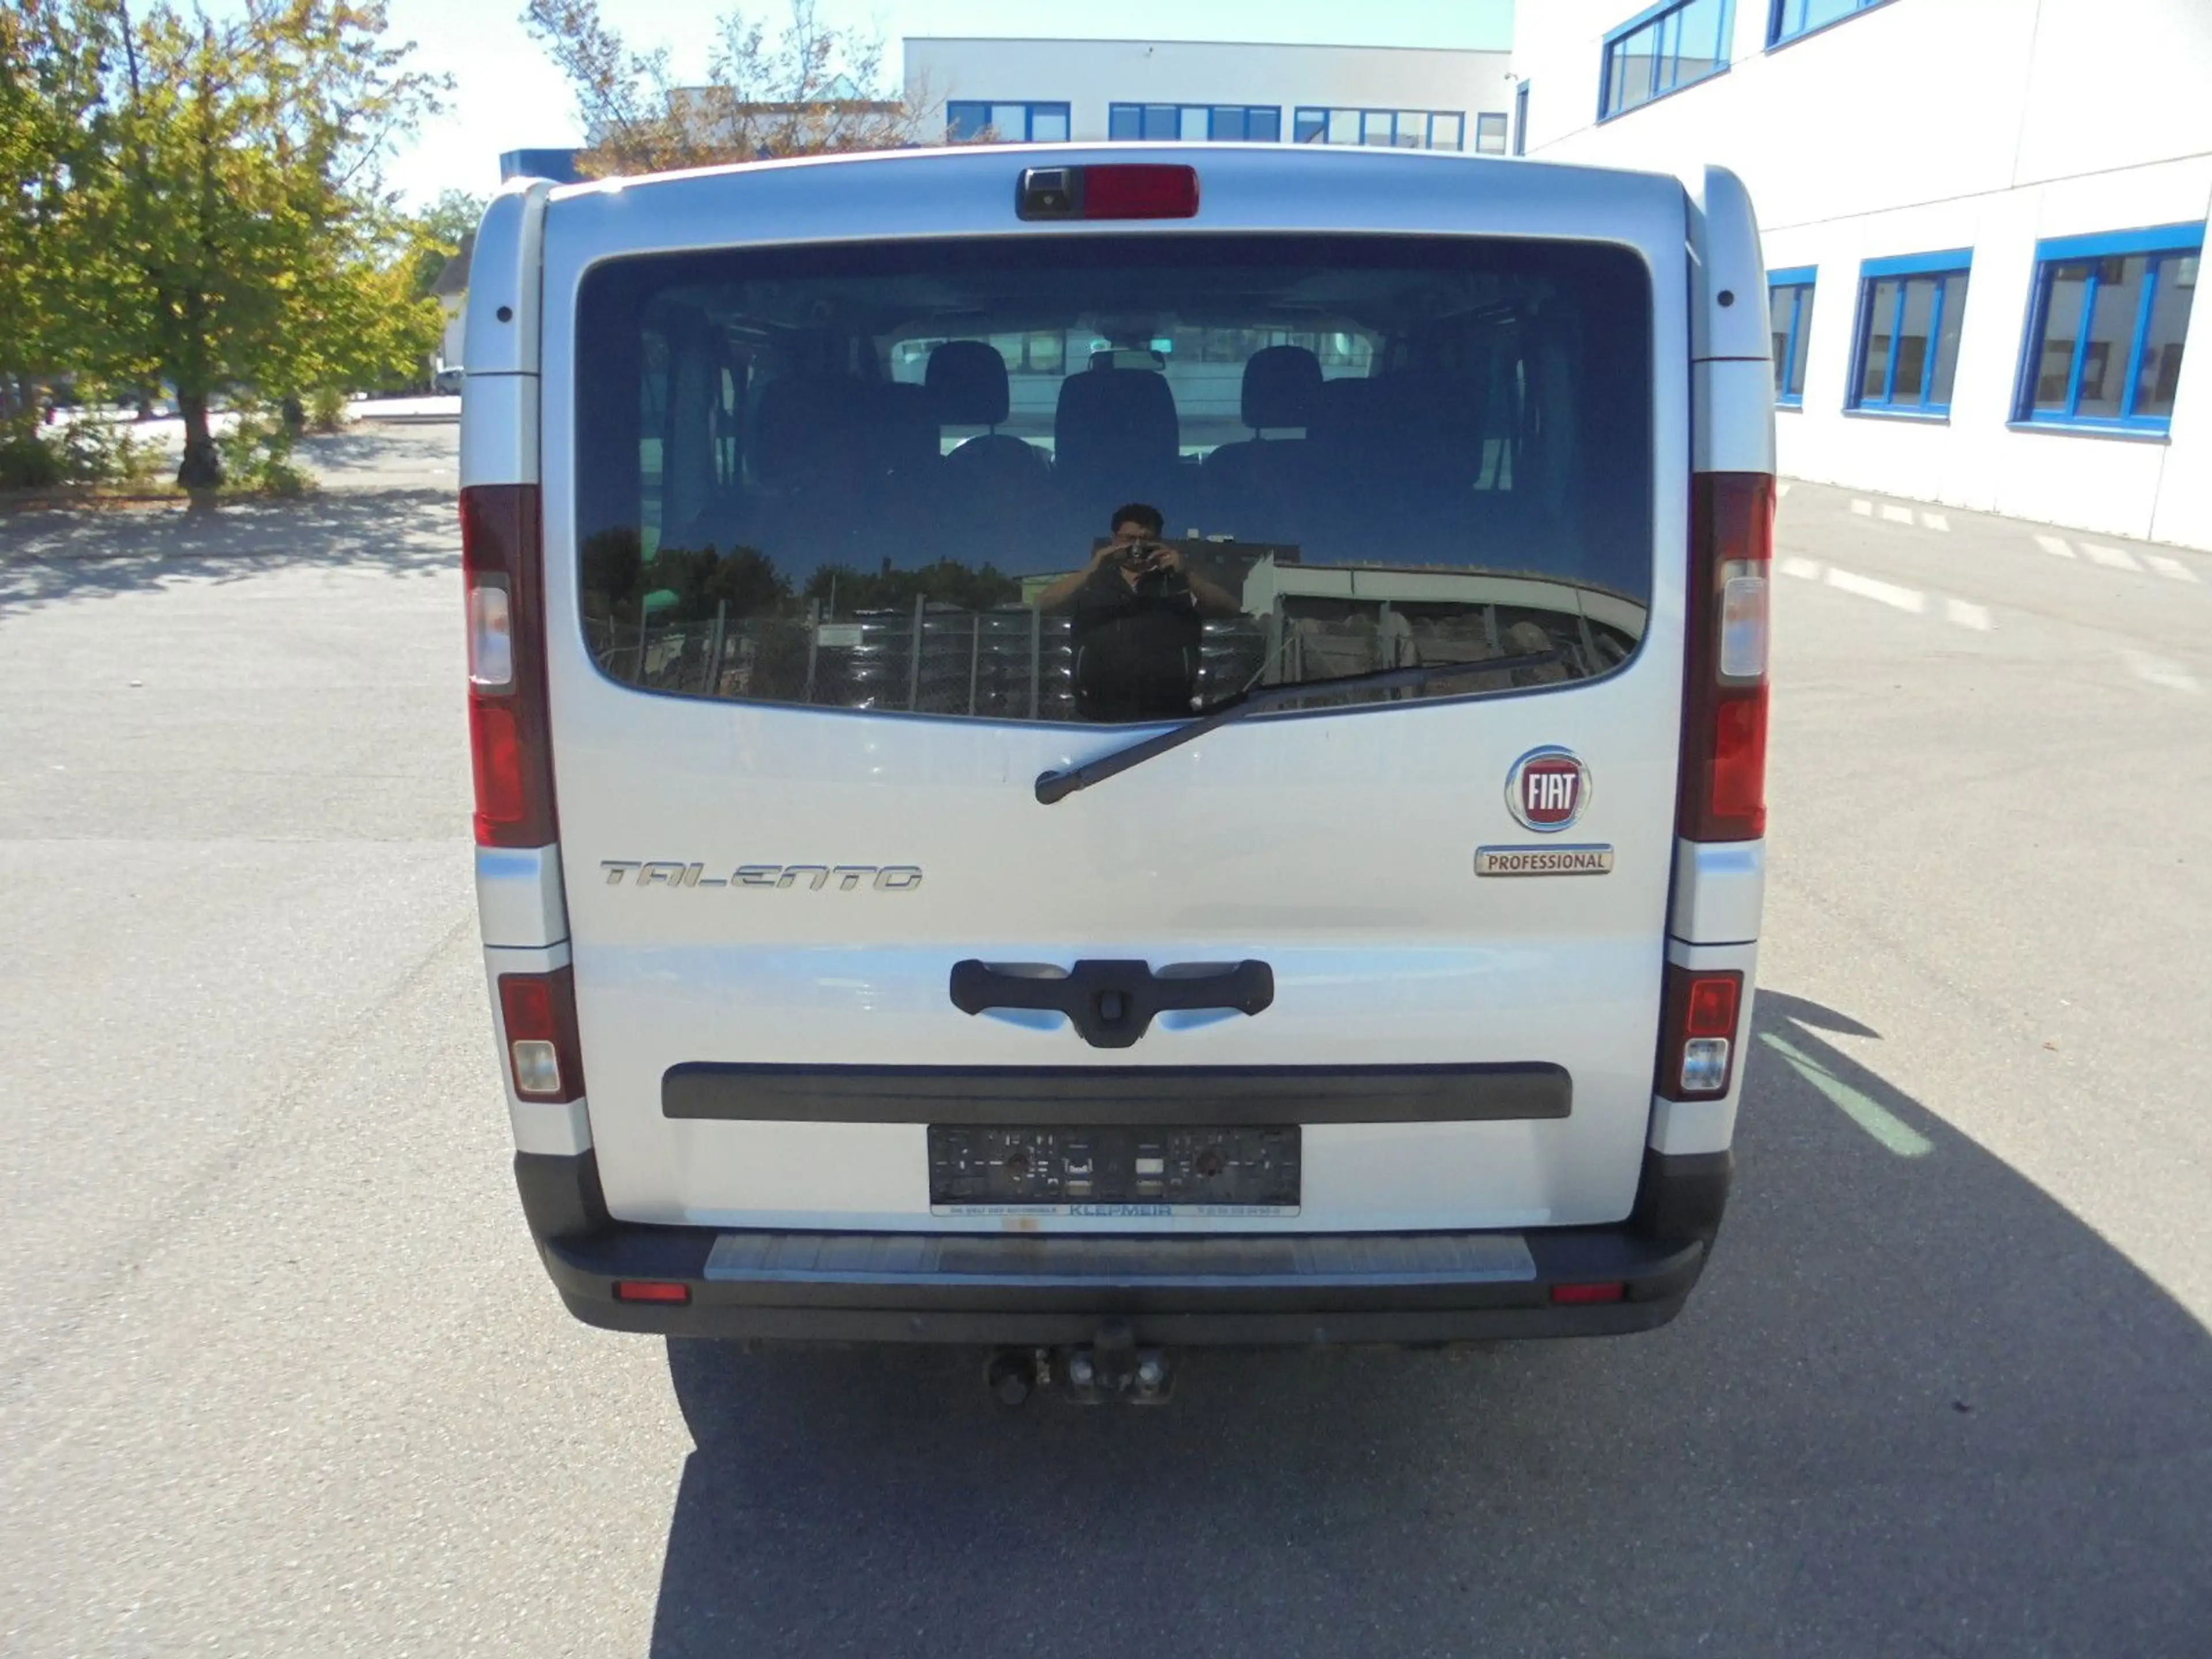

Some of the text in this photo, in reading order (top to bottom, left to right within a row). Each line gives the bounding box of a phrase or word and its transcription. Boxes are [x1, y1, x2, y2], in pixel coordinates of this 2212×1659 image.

[1528, 774, 1576, 810] FIAT
[600, 860, 922, 891] TALENTO
[1488, 855, 1604, 870] PROFESSIONAL
